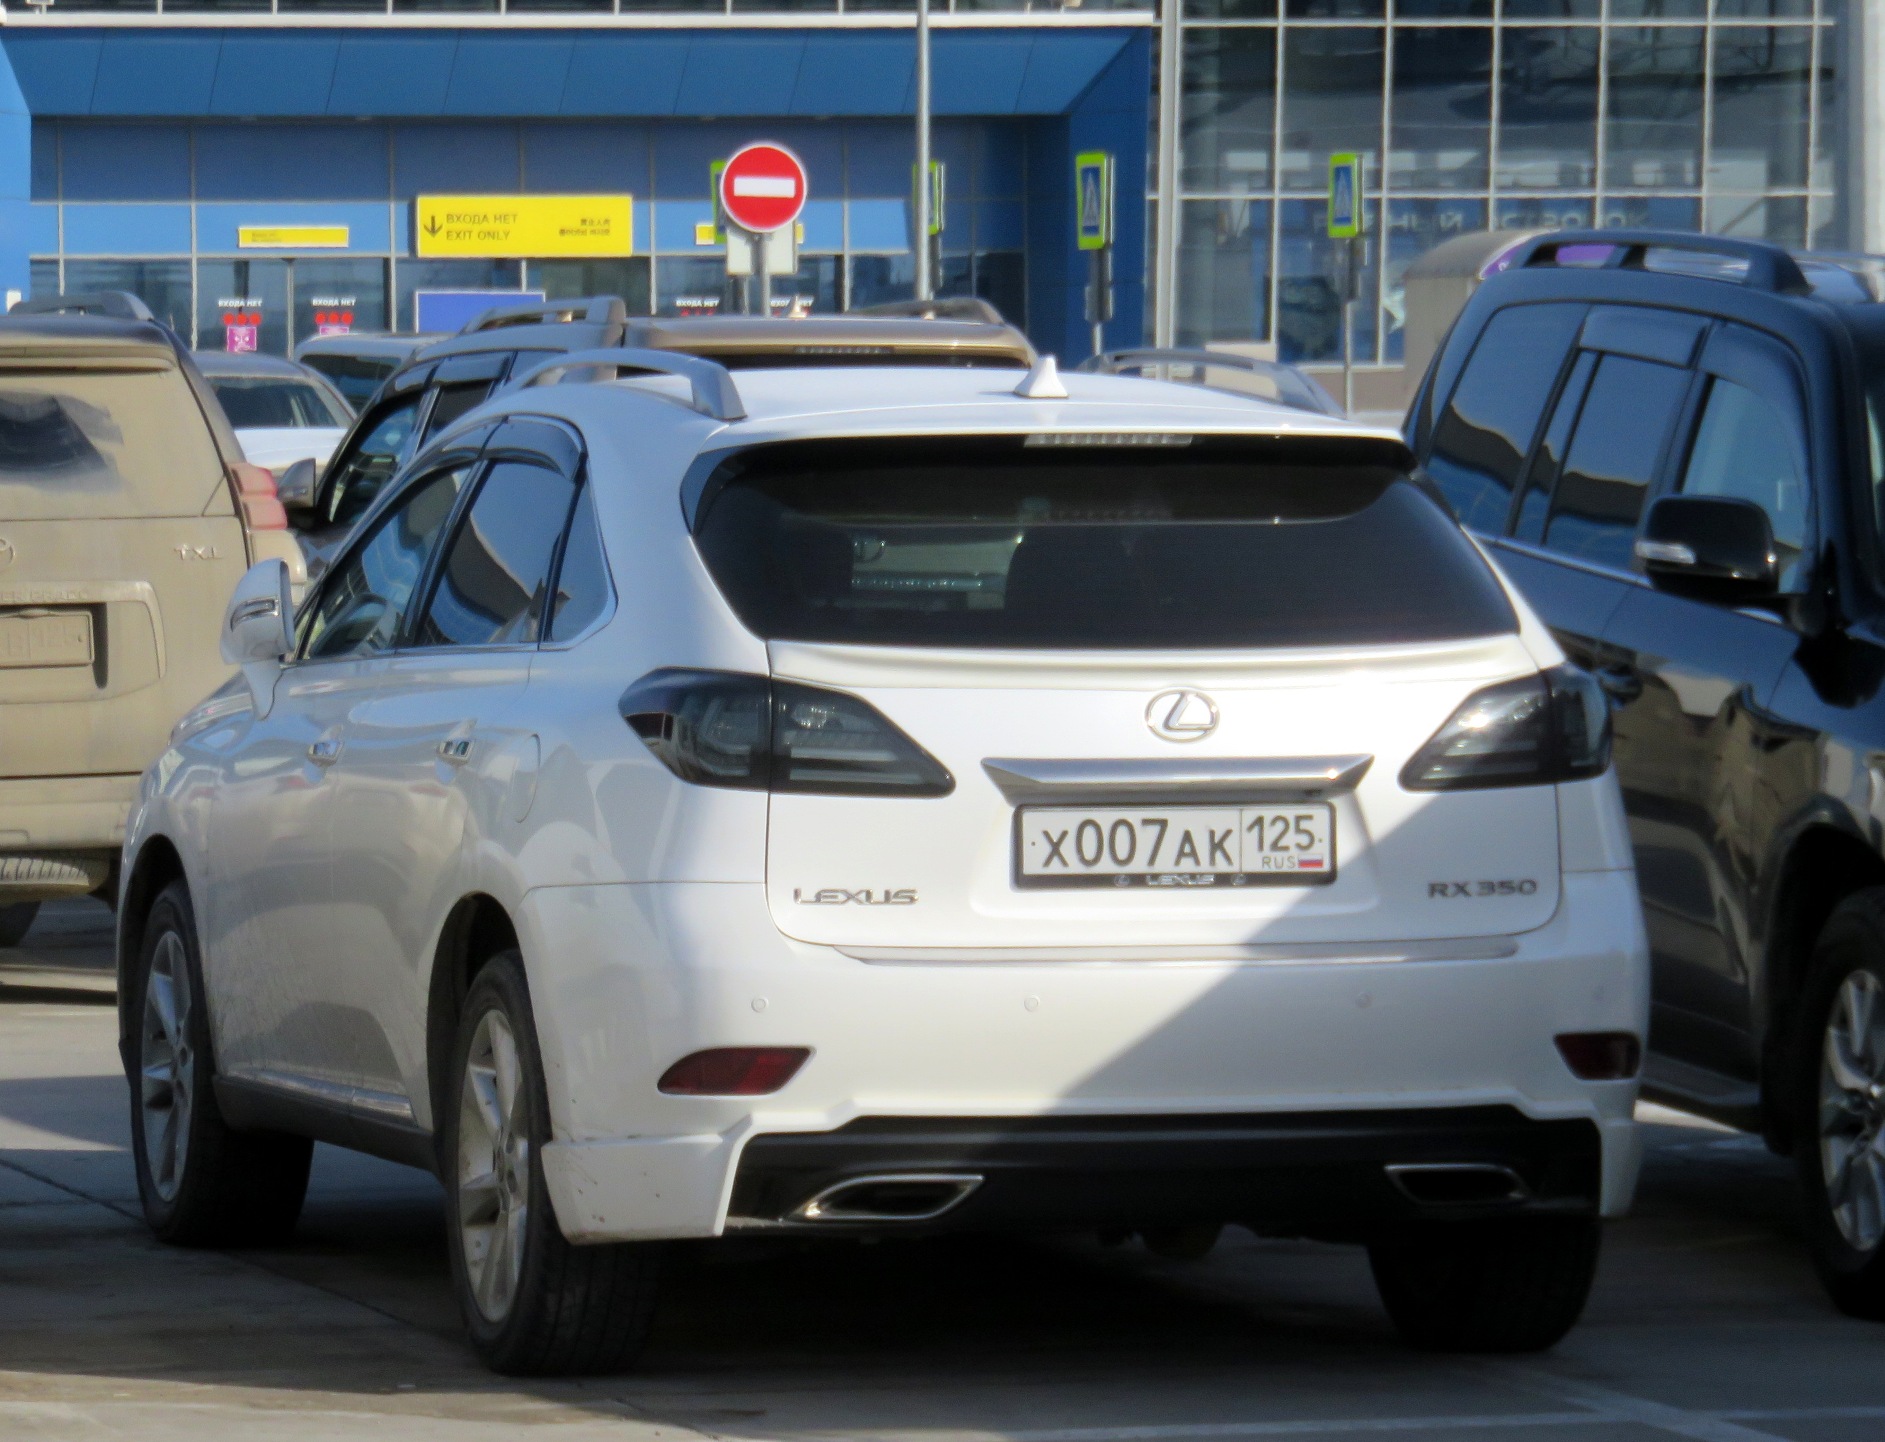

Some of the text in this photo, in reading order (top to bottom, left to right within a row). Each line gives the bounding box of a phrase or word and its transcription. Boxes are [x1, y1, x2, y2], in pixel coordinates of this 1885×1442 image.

[446, 213, 518, 225] ВХОДА НЕТ
[446, 230, 511, 240] EXIT ONLY
[1246, 815, 1316, 852] 125
[1262, 856, 1296, 869] RUS
[1146, 874, 1215, 886] LEXUS
[1428, 879, 1537, 898] RX 350
[792, 886, 919, 905] LEXUS
